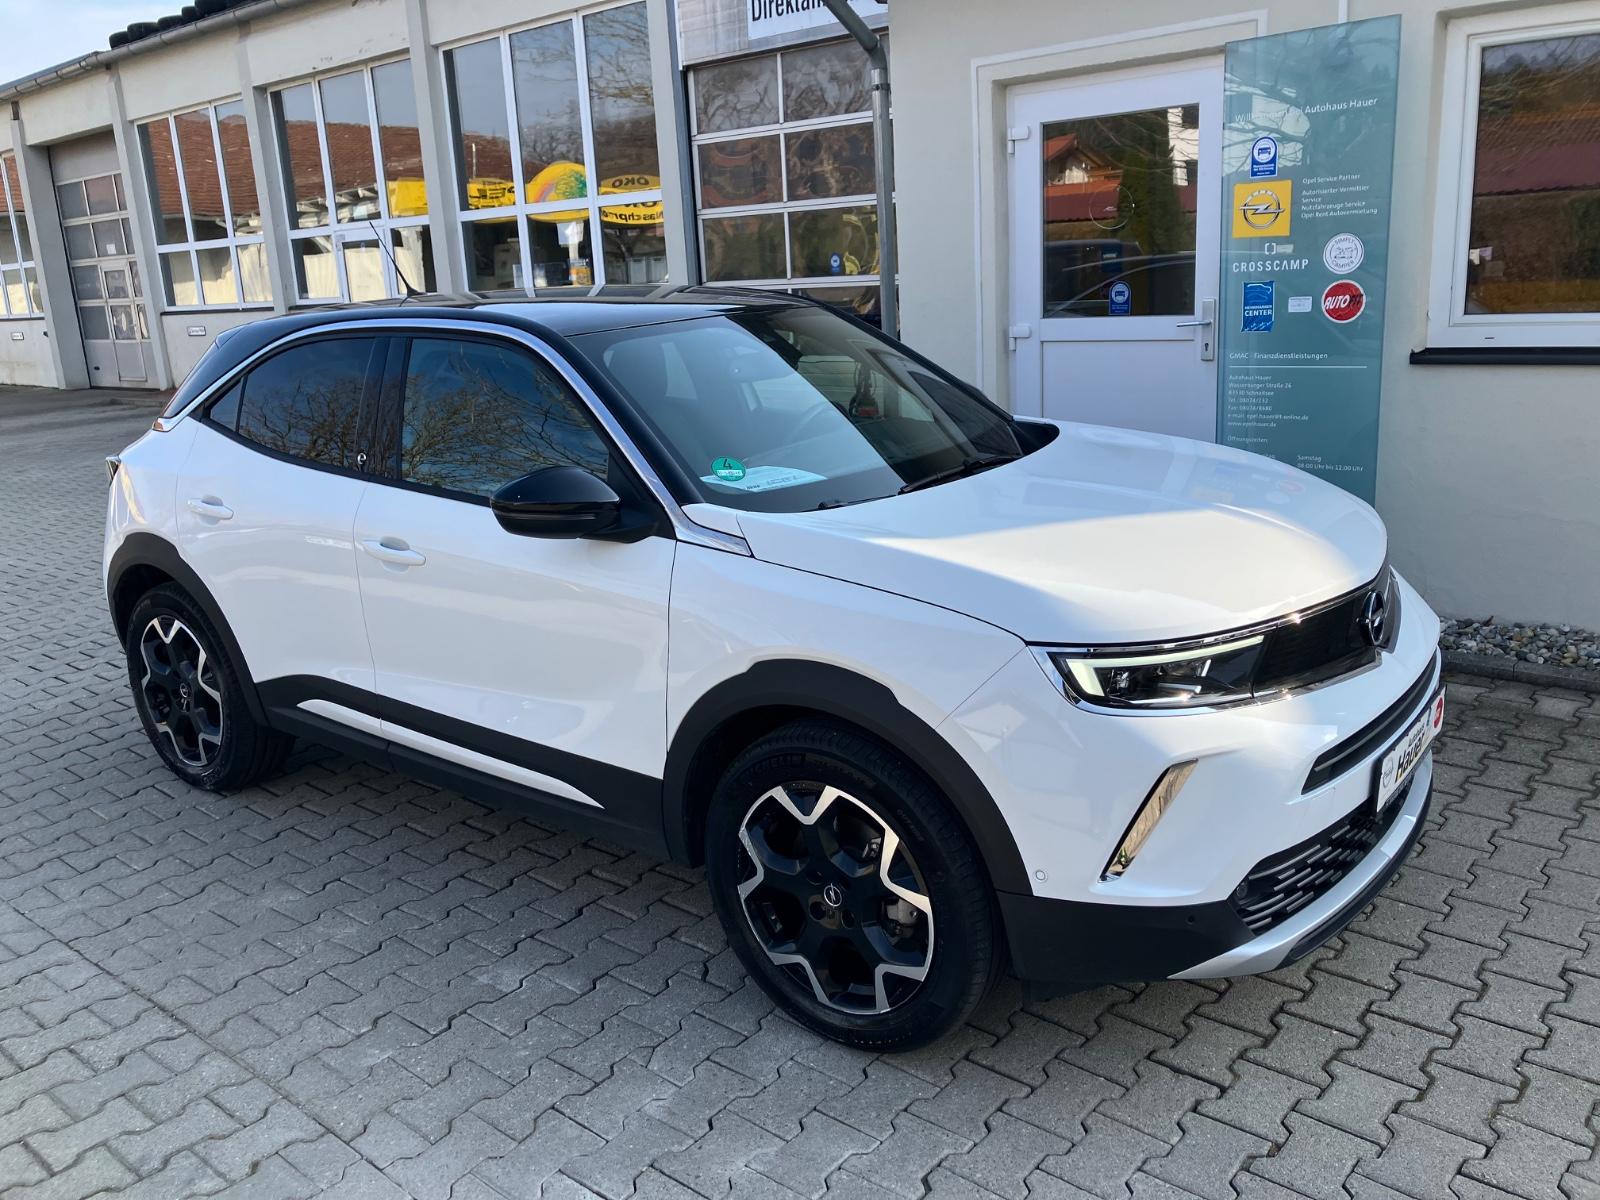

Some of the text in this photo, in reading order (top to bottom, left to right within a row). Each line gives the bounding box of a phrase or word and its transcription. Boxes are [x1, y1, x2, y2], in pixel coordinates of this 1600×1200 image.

[752, 0, 827, 21] Direktan
[1305, 102, 1347, 113] Autohaus
[1350, 97, 1378, 108] Hauer
[1232, 258, 1309, 273] CROSSCAMP
[1244, 309, 1273, 317] CENTER
[1254, 352, 1328, 360] Finanzdienstleistungen
[722, 458, 733, 470] 4
[1394, 732, 1426, 783] Hauer
